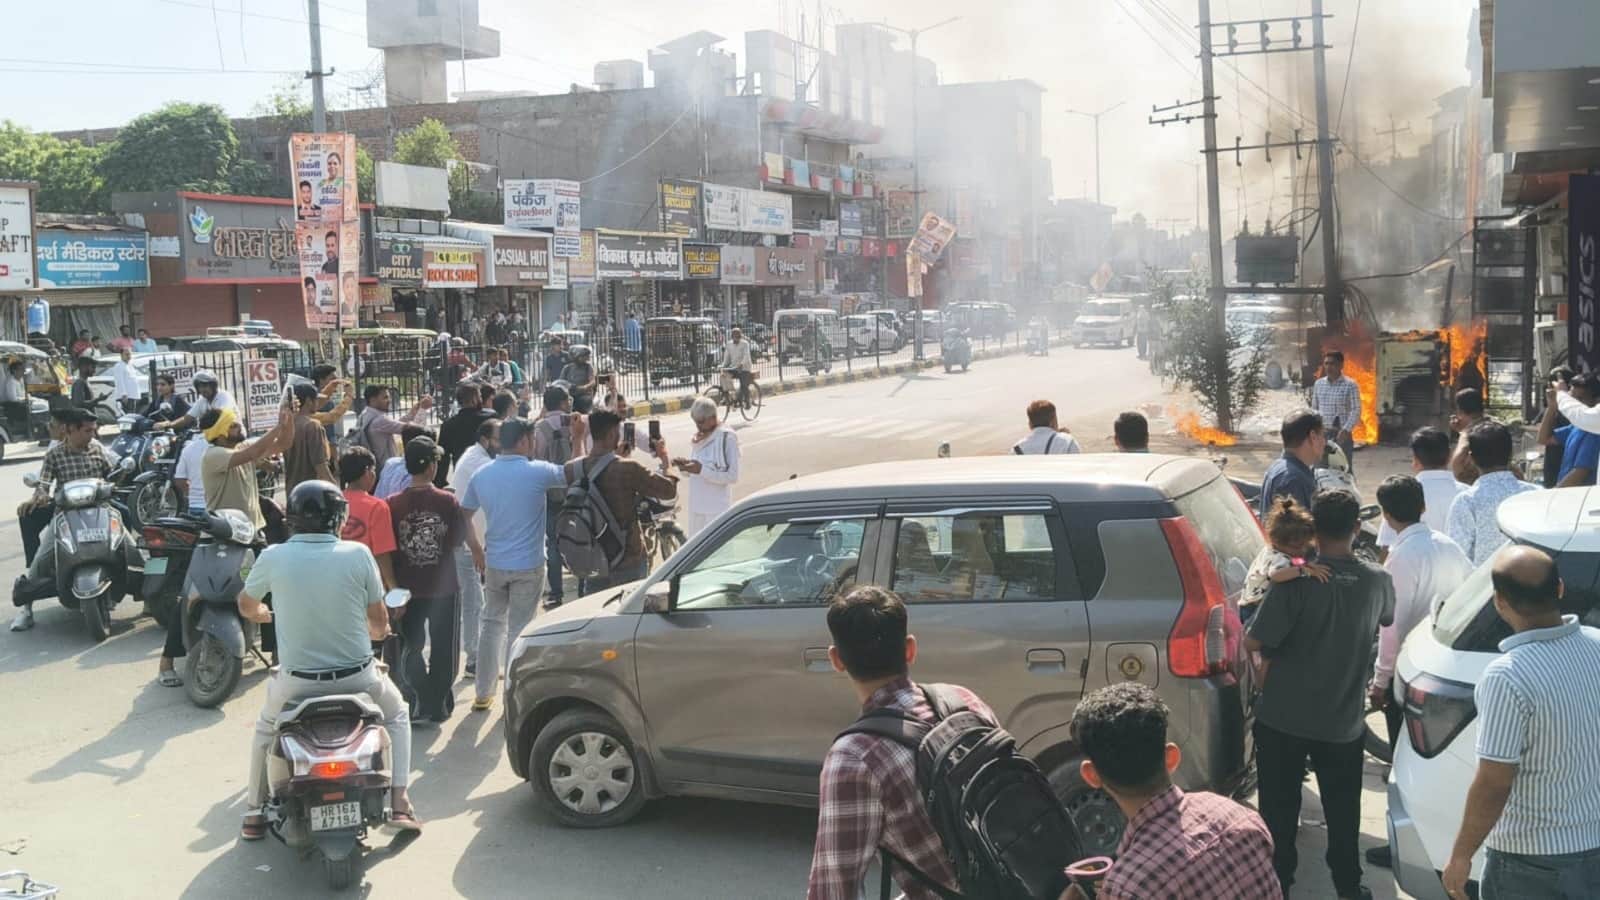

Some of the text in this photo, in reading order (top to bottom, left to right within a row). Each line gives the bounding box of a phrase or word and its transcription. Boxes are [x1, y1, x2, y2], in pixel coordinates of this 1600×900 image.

[512, 191, 546, 206] पंकज
[214, 226, 266, 259] भारत
[117, 243, 145, 261] स्टोर
[391, 254, 412, 266] CITY
[494, 248, 529, 266] CASUAL
[530, 249, 547, 266] HUT
[599, 243, 628, 264] विकास
[379, 267, 423, 280] OPTICALS
[249, 362, 278, 382] KS
[251, 383, 278, 395] STENO
[320, 803, 356, 817] HR16A
